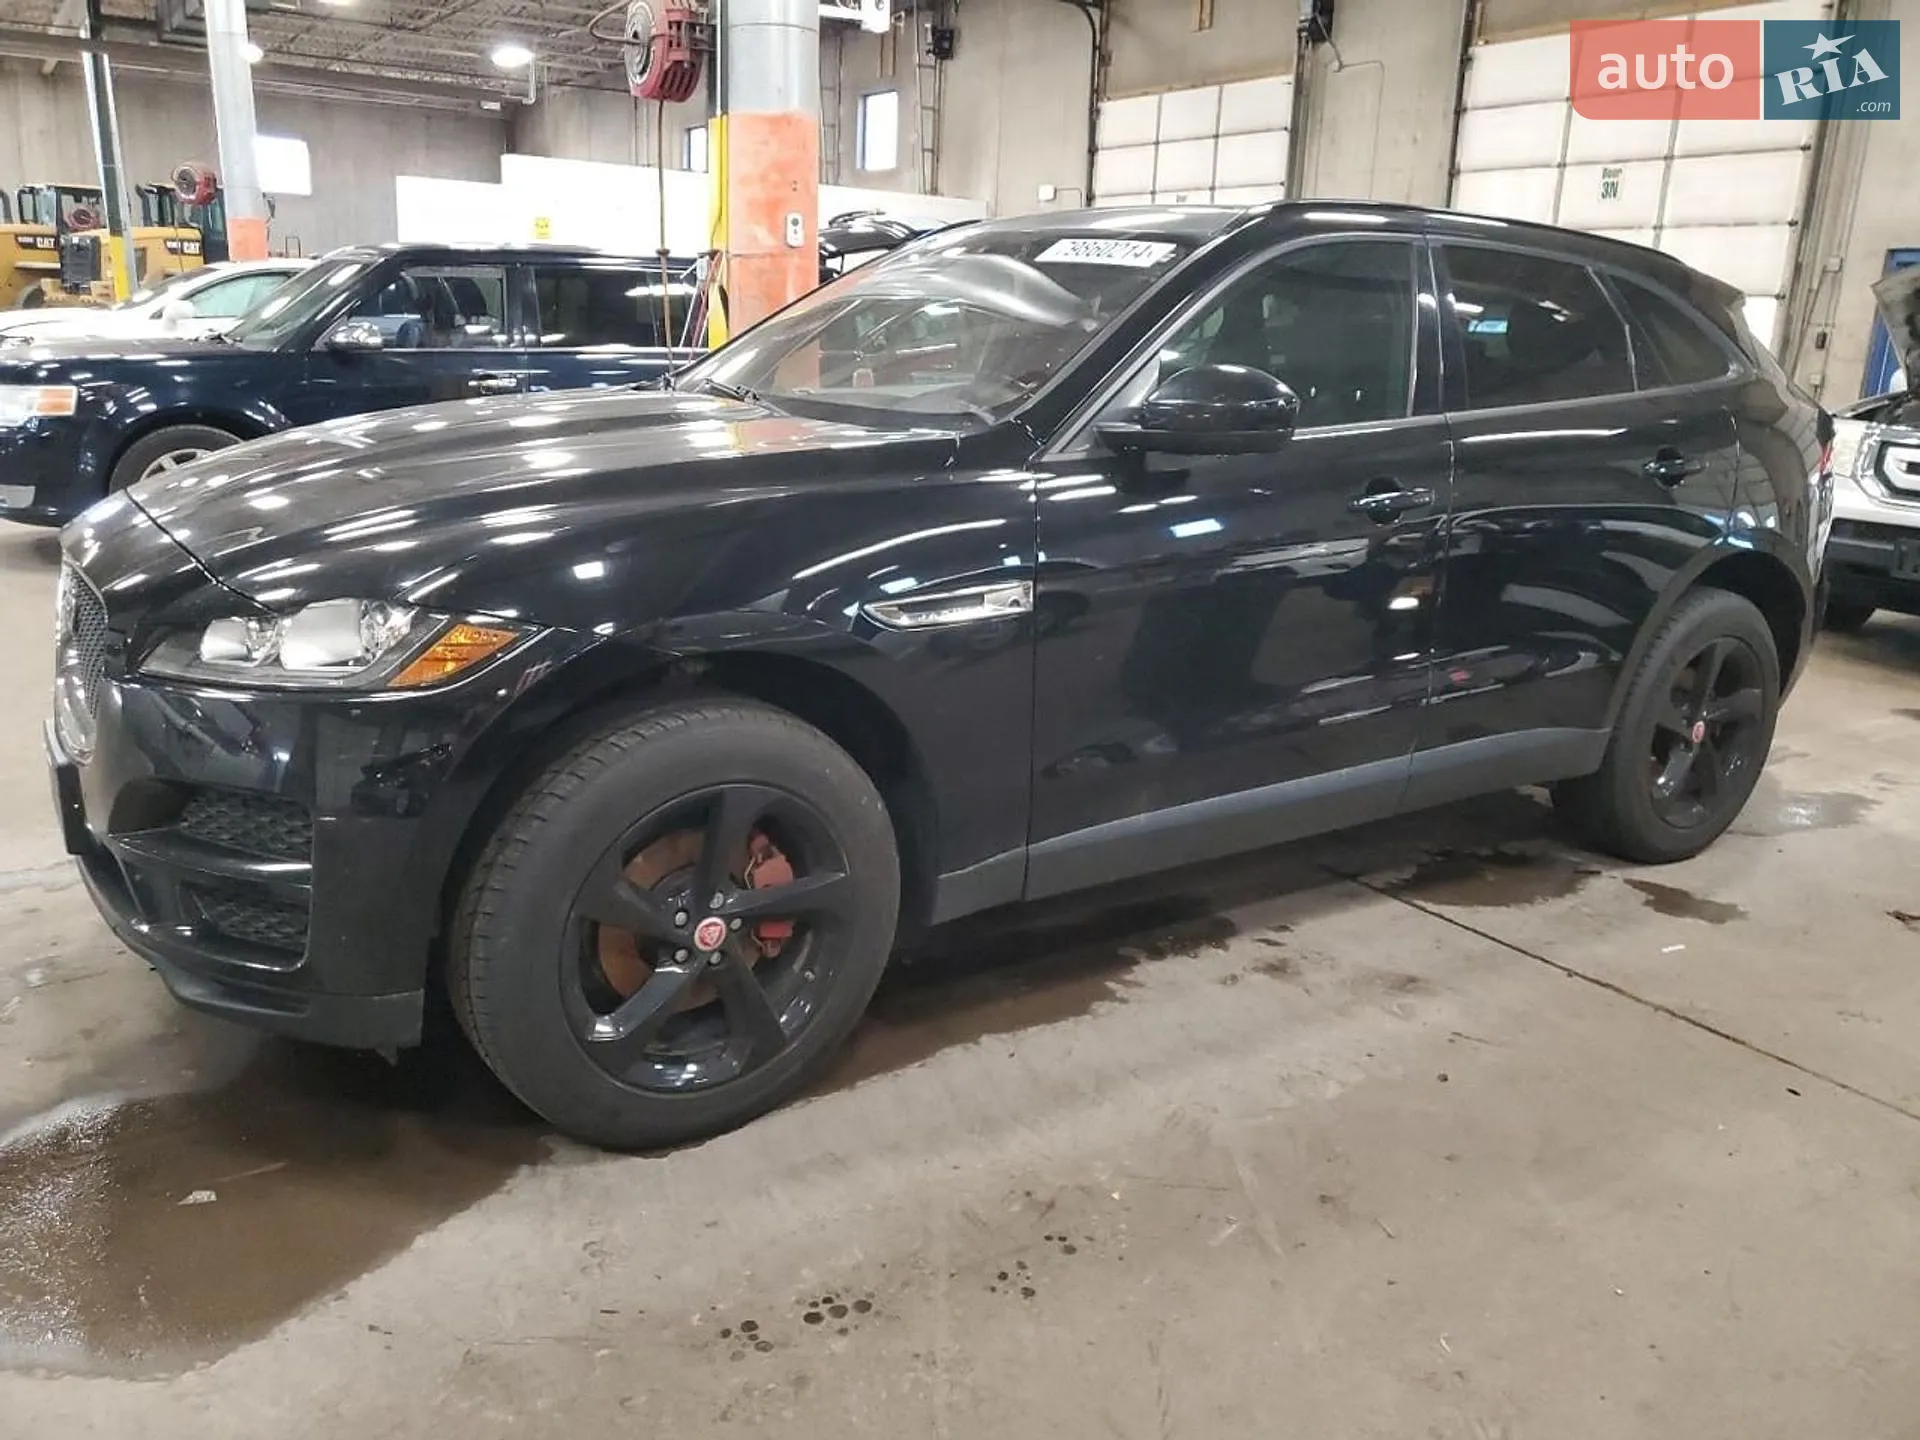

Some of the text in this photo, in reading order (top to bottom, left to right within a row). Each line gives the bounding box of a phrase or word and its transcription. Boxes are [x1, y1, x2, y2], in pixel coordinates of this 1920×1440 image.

[1601, 180, 1619, 199] 3N
[36, 237, 55, 249] CAT
[183, 241, 200, 254] CAT
